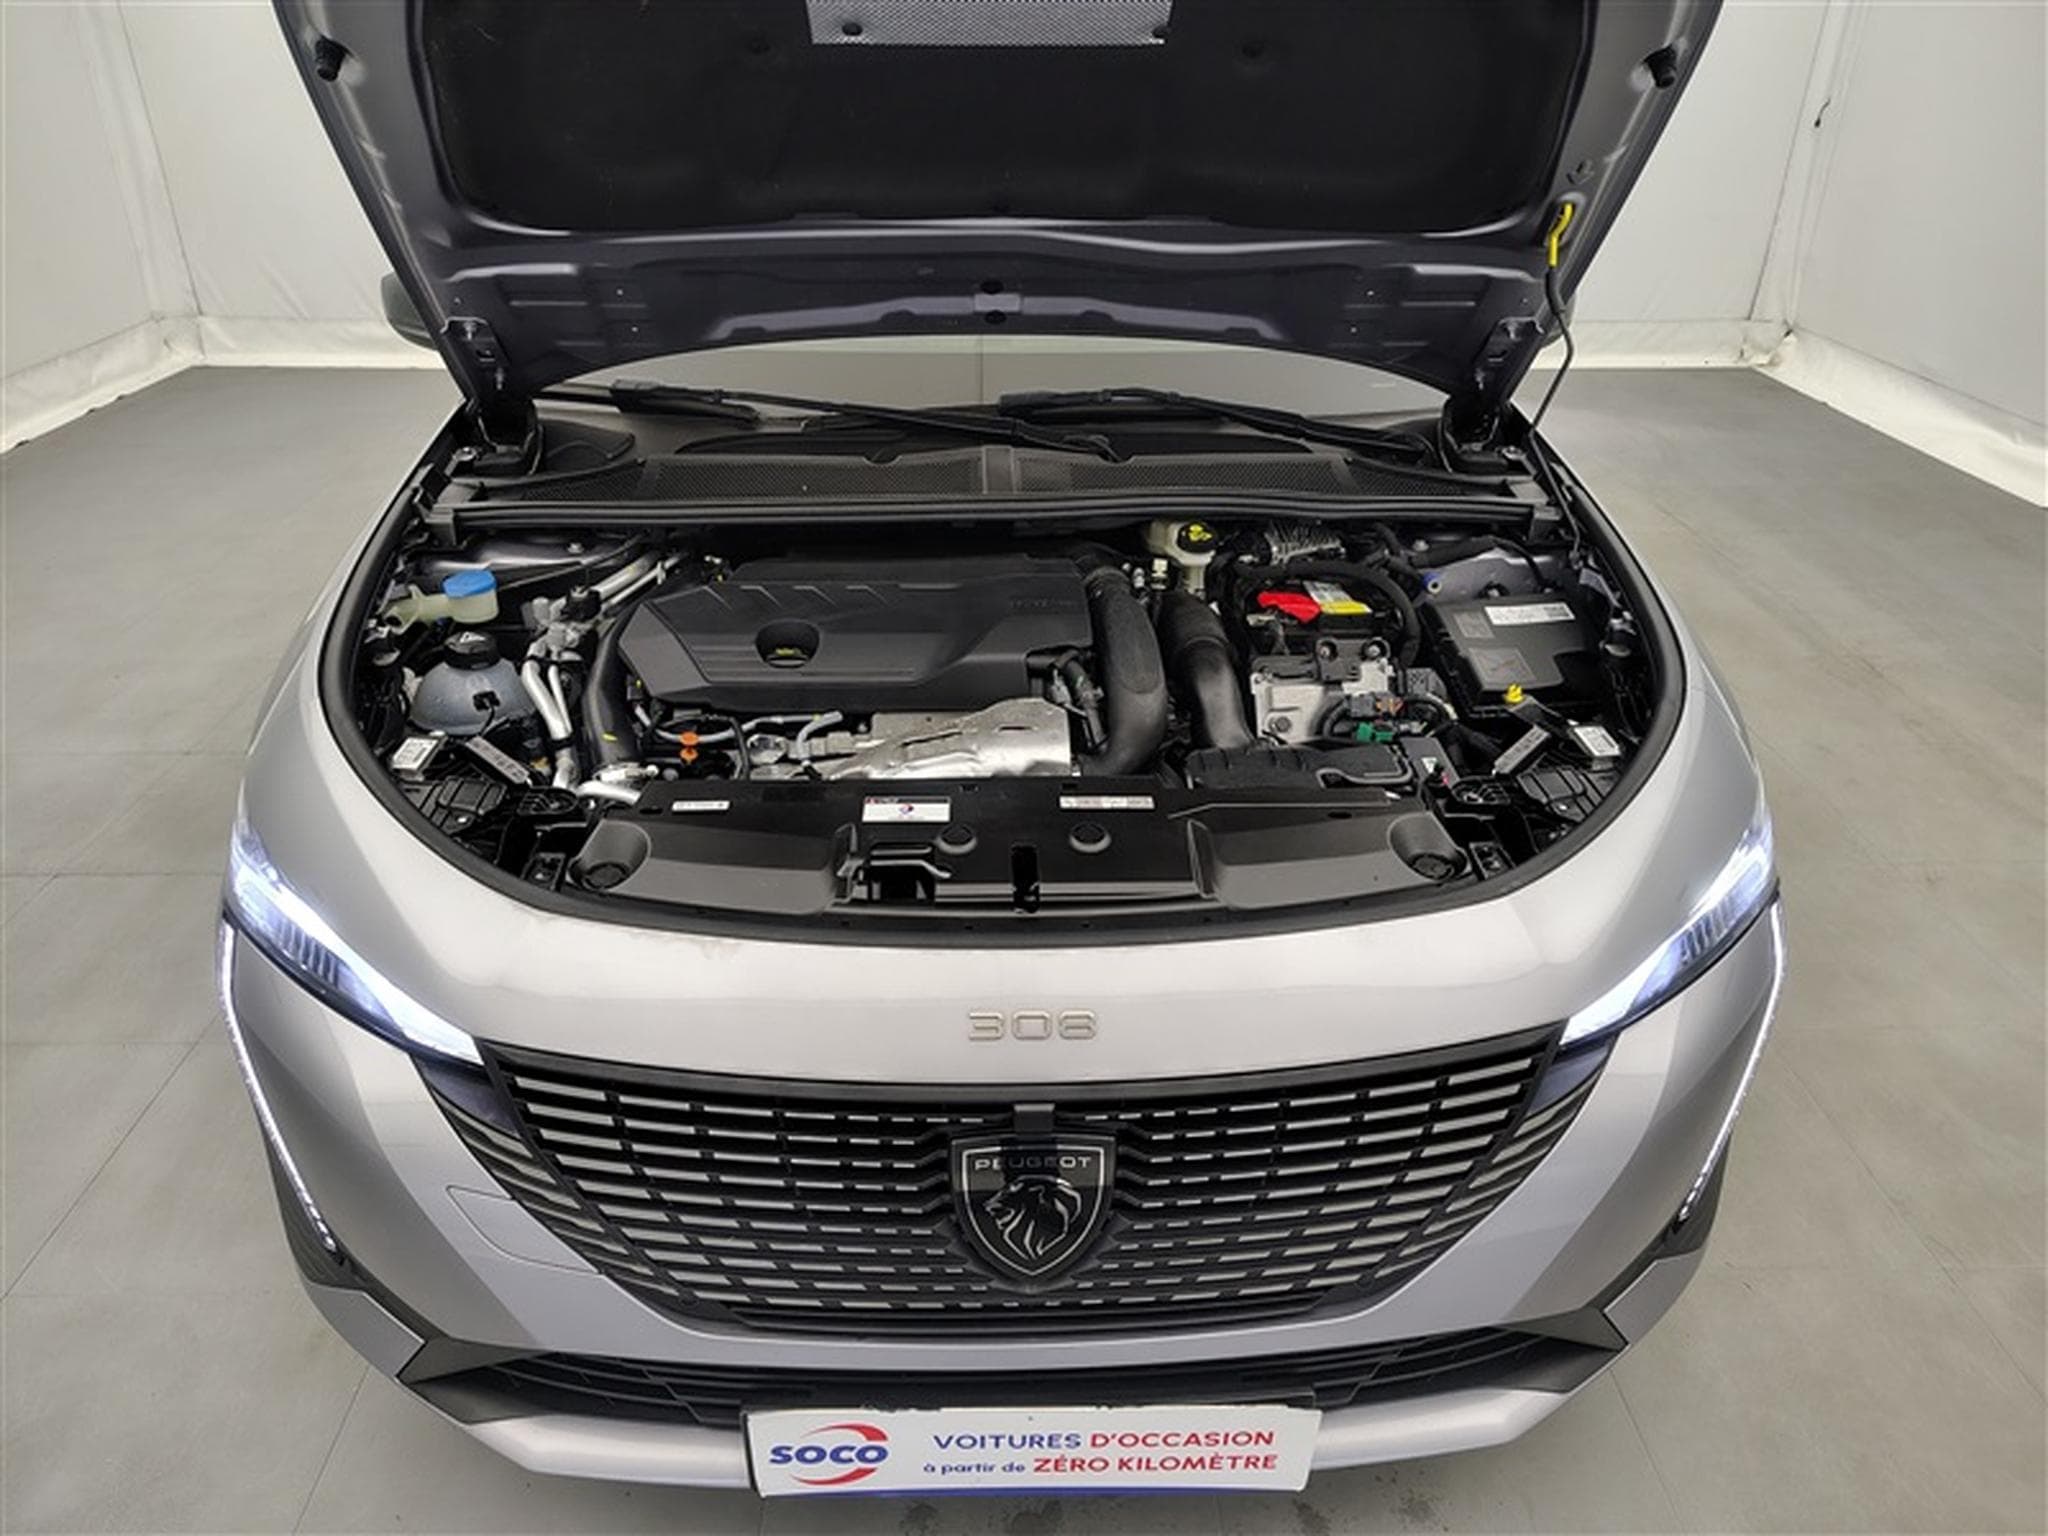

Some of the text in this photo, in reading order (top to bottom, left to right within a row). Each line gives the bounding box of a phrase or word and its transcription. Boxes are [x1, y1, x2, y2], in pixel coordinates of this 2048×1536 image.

[969, 1011, 1097, 1041] 308
[974, 1156, 1091, 1171] PEUGEOT
[933, 1430, 1275, 1450] VOITURES D'OCCASION
[769, 1444, 888, 1465] SOCO
[923, 1454, 1279, 1476] à partir de ZÉRO KILOMÈTRE
